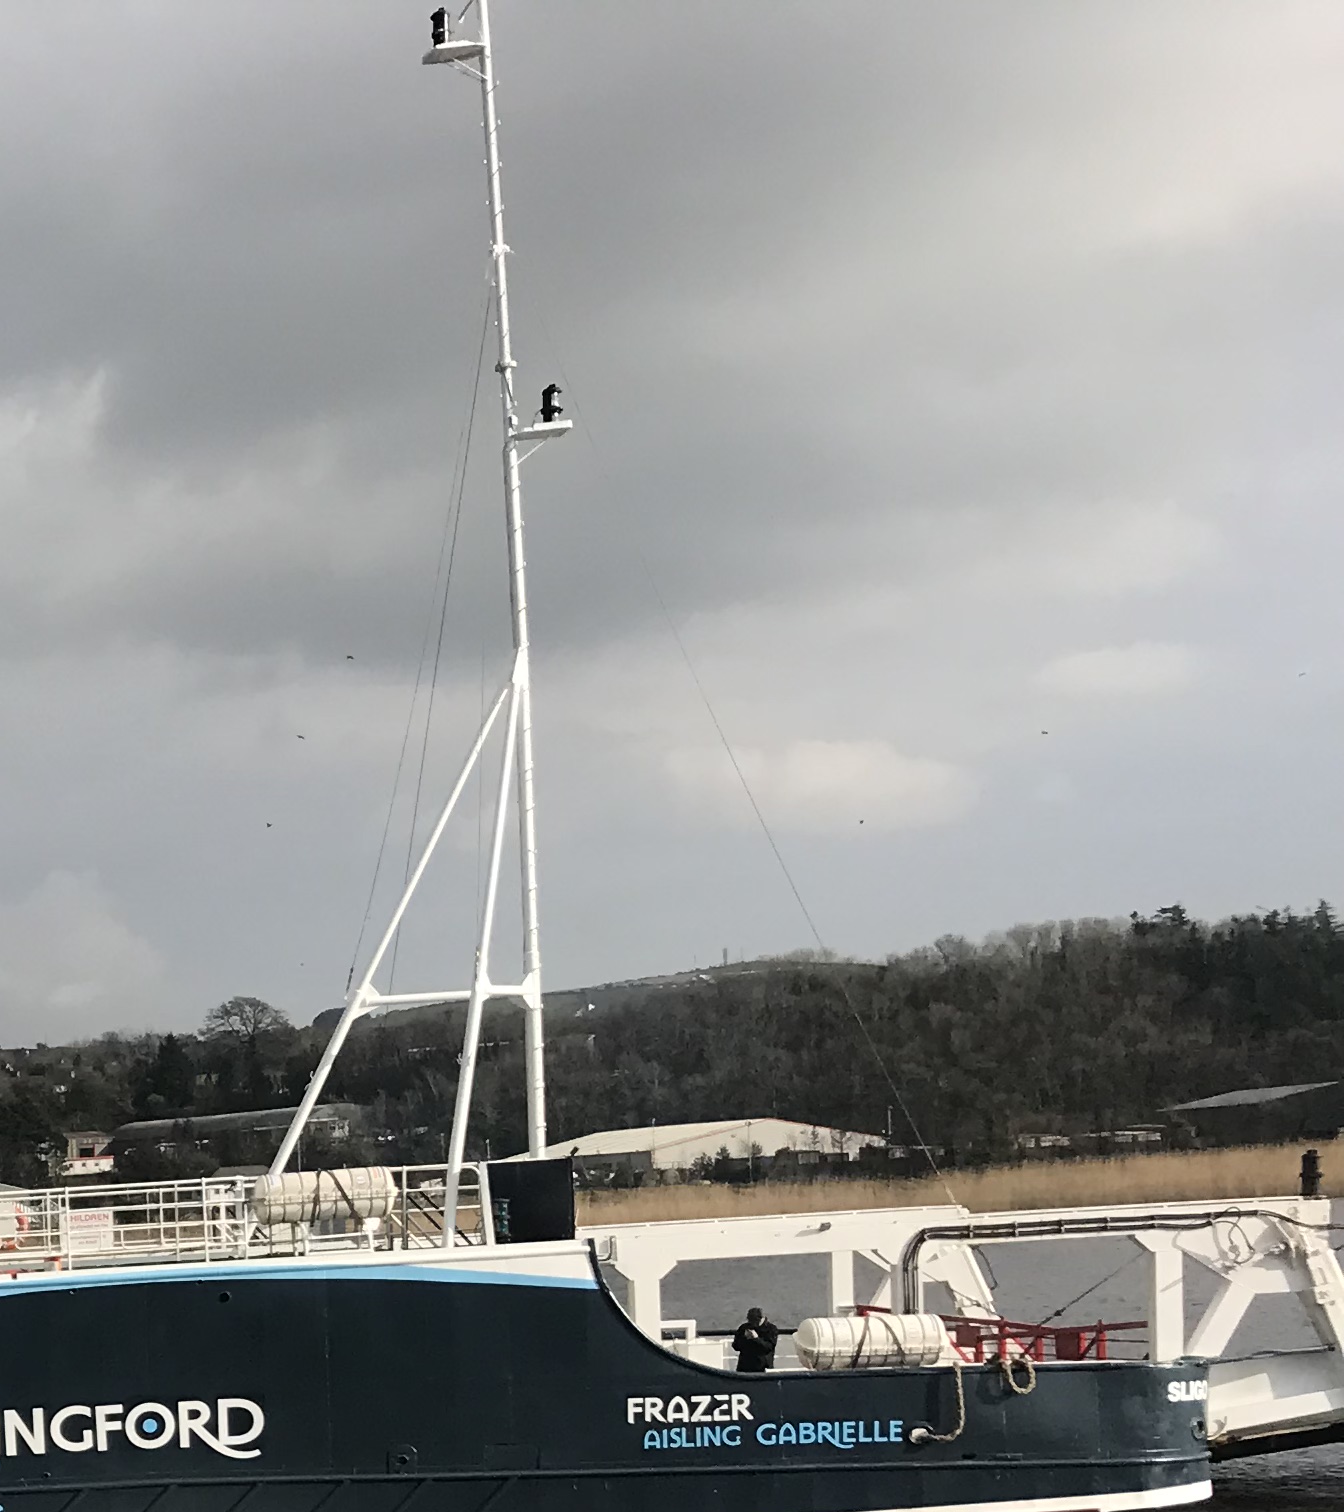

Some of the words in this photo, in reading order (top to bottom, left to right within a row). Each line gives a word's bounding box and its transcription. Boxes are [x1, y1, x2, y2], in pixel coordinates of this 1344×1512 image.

[1167, 1380, 1208, 1403] SLIGO
[627, 1393, 754, 1424] FRAZER
[643, 1425, 741, 1450] AISLING
[756, 1420, 903, 1449] GABRIELLE
